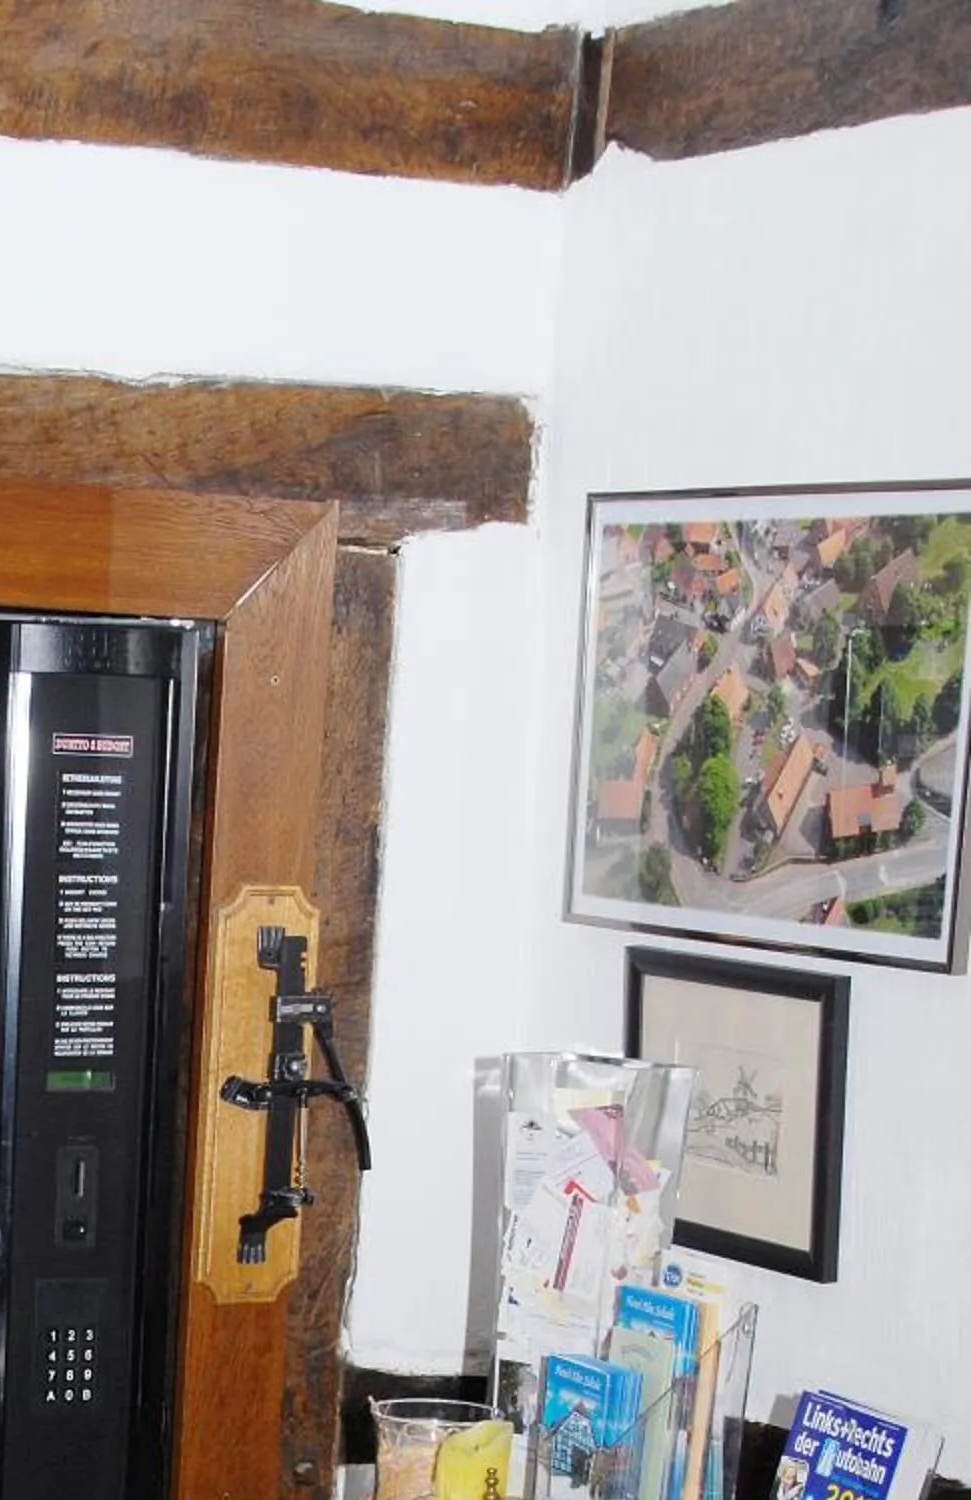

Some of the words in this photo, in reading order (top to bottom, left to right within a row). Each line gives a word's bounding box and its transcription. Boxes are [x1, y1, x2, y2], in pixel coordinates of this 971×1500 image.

[802, 1401, 896, 1458] Links+Rechts
[794, 1432, 820, 1457] der
[815, 1437, 886, 1485] Autobahn
